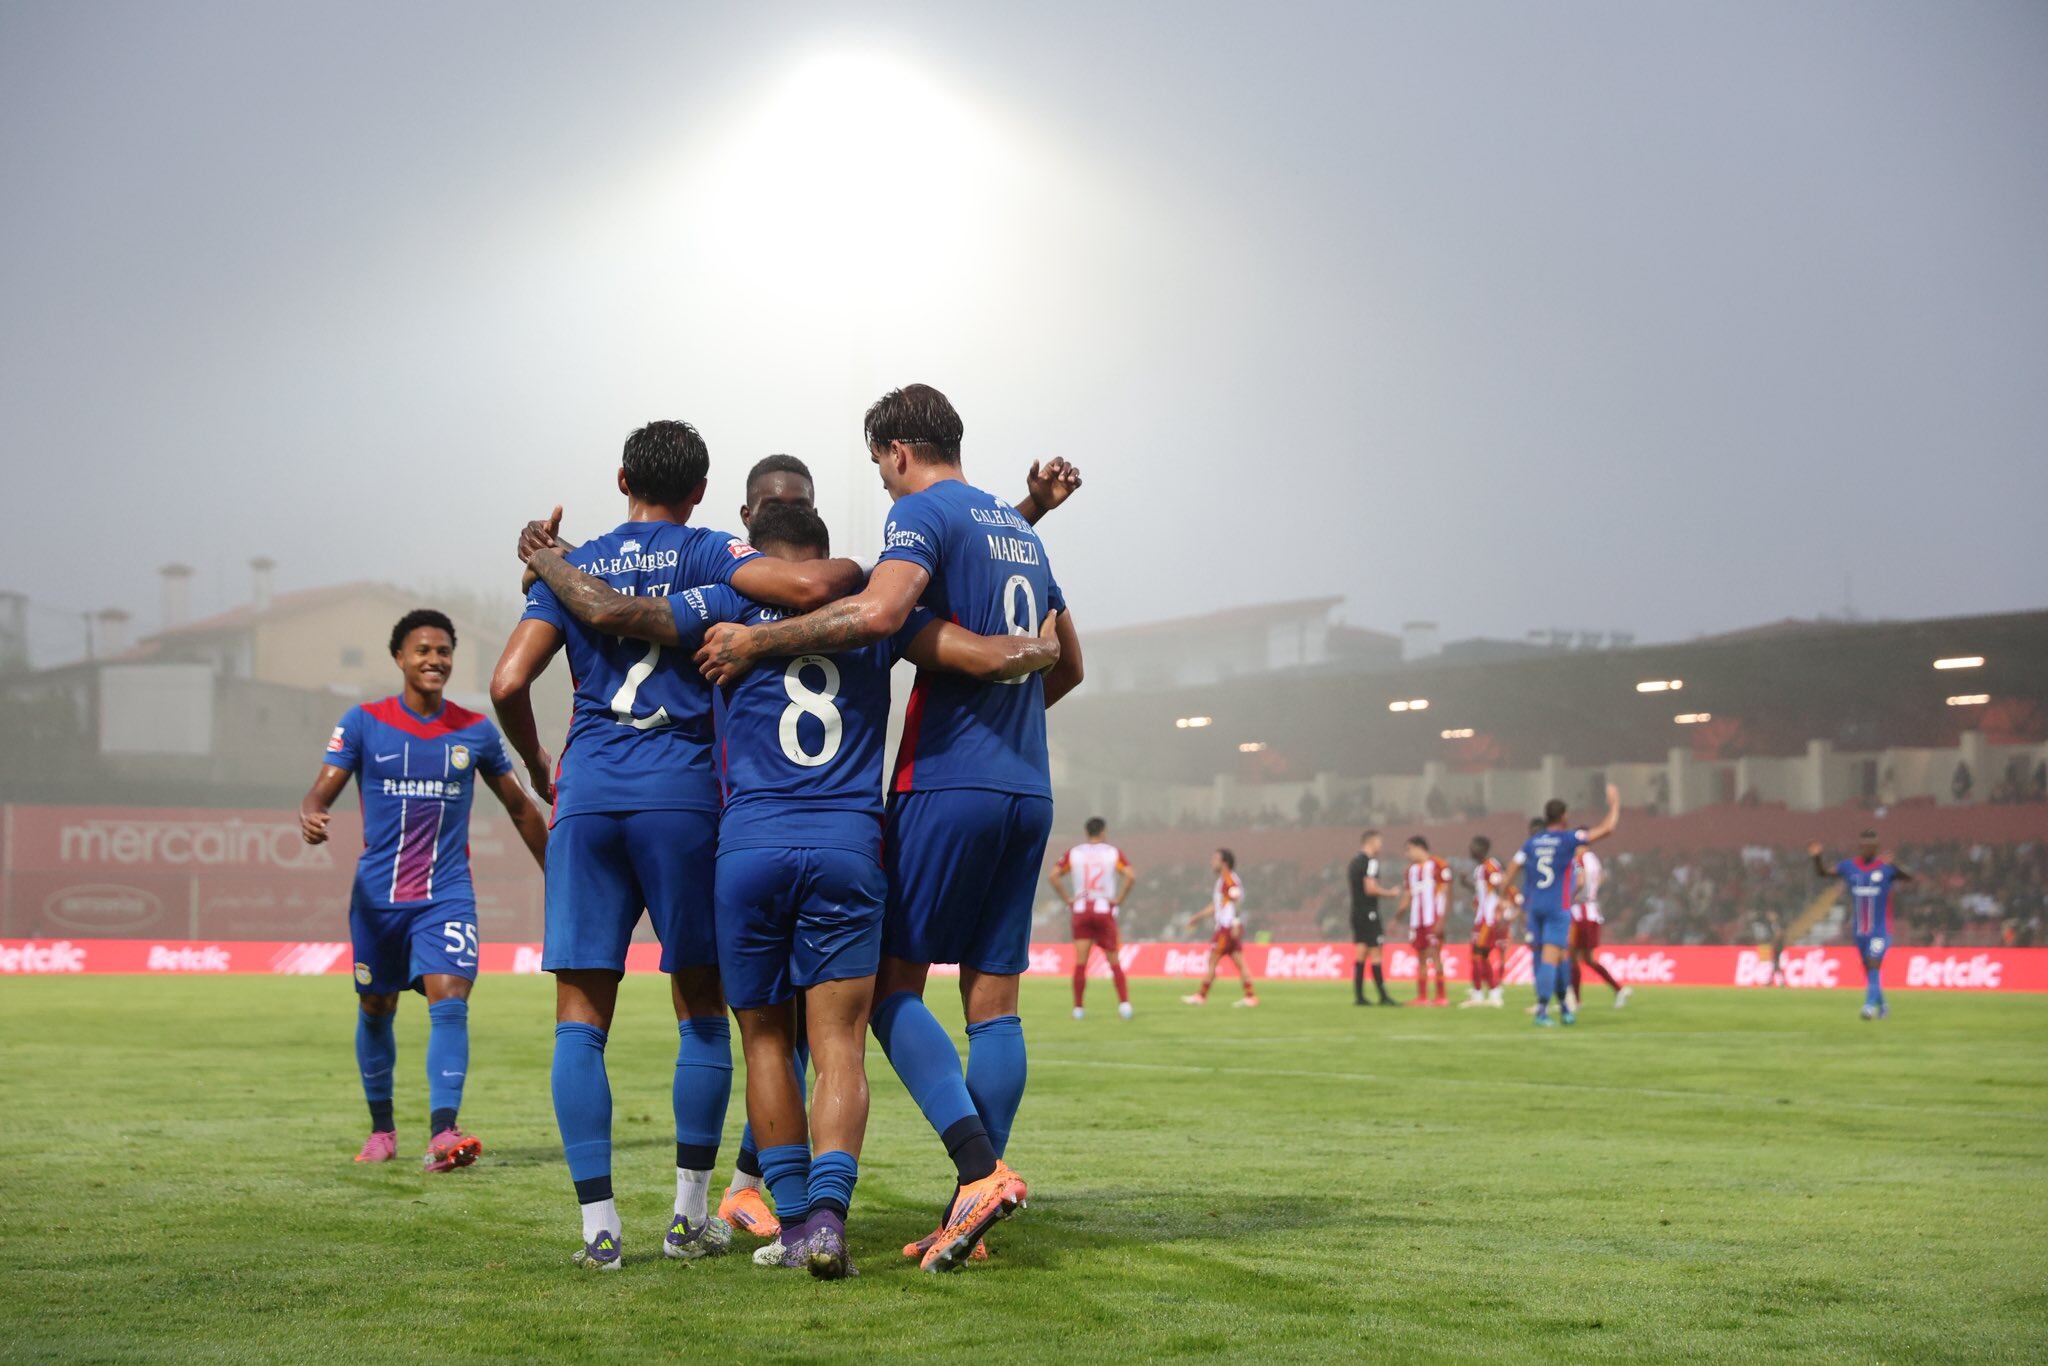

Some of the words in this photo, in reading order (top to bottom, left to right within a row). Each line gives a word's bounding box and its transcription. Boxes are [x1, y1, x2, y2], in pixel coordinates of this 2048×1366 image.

[970, 507, 1035, 533] CALHA
[888, 530, 926, 545] OSPITAL
[895, 538, 915, 548] LUZ
[986, 534, 1040, 566] MAREZI
[610, 639, 673, 730] 2
[778, 654, 843, 767] 8
[383, 778, 444, 797] PLACARD
[1536, 855, 1556, 889] 5
[443, 921, 478, 958] 55
[0, 941, 87, 973] etclic
[147, 945, 231, 972] Betclic
[1163, 948, 1210, 975] Betcl
[1265, 946, 1344, 978] Betclic
[1906, 953, 2003, 988] Betclic
